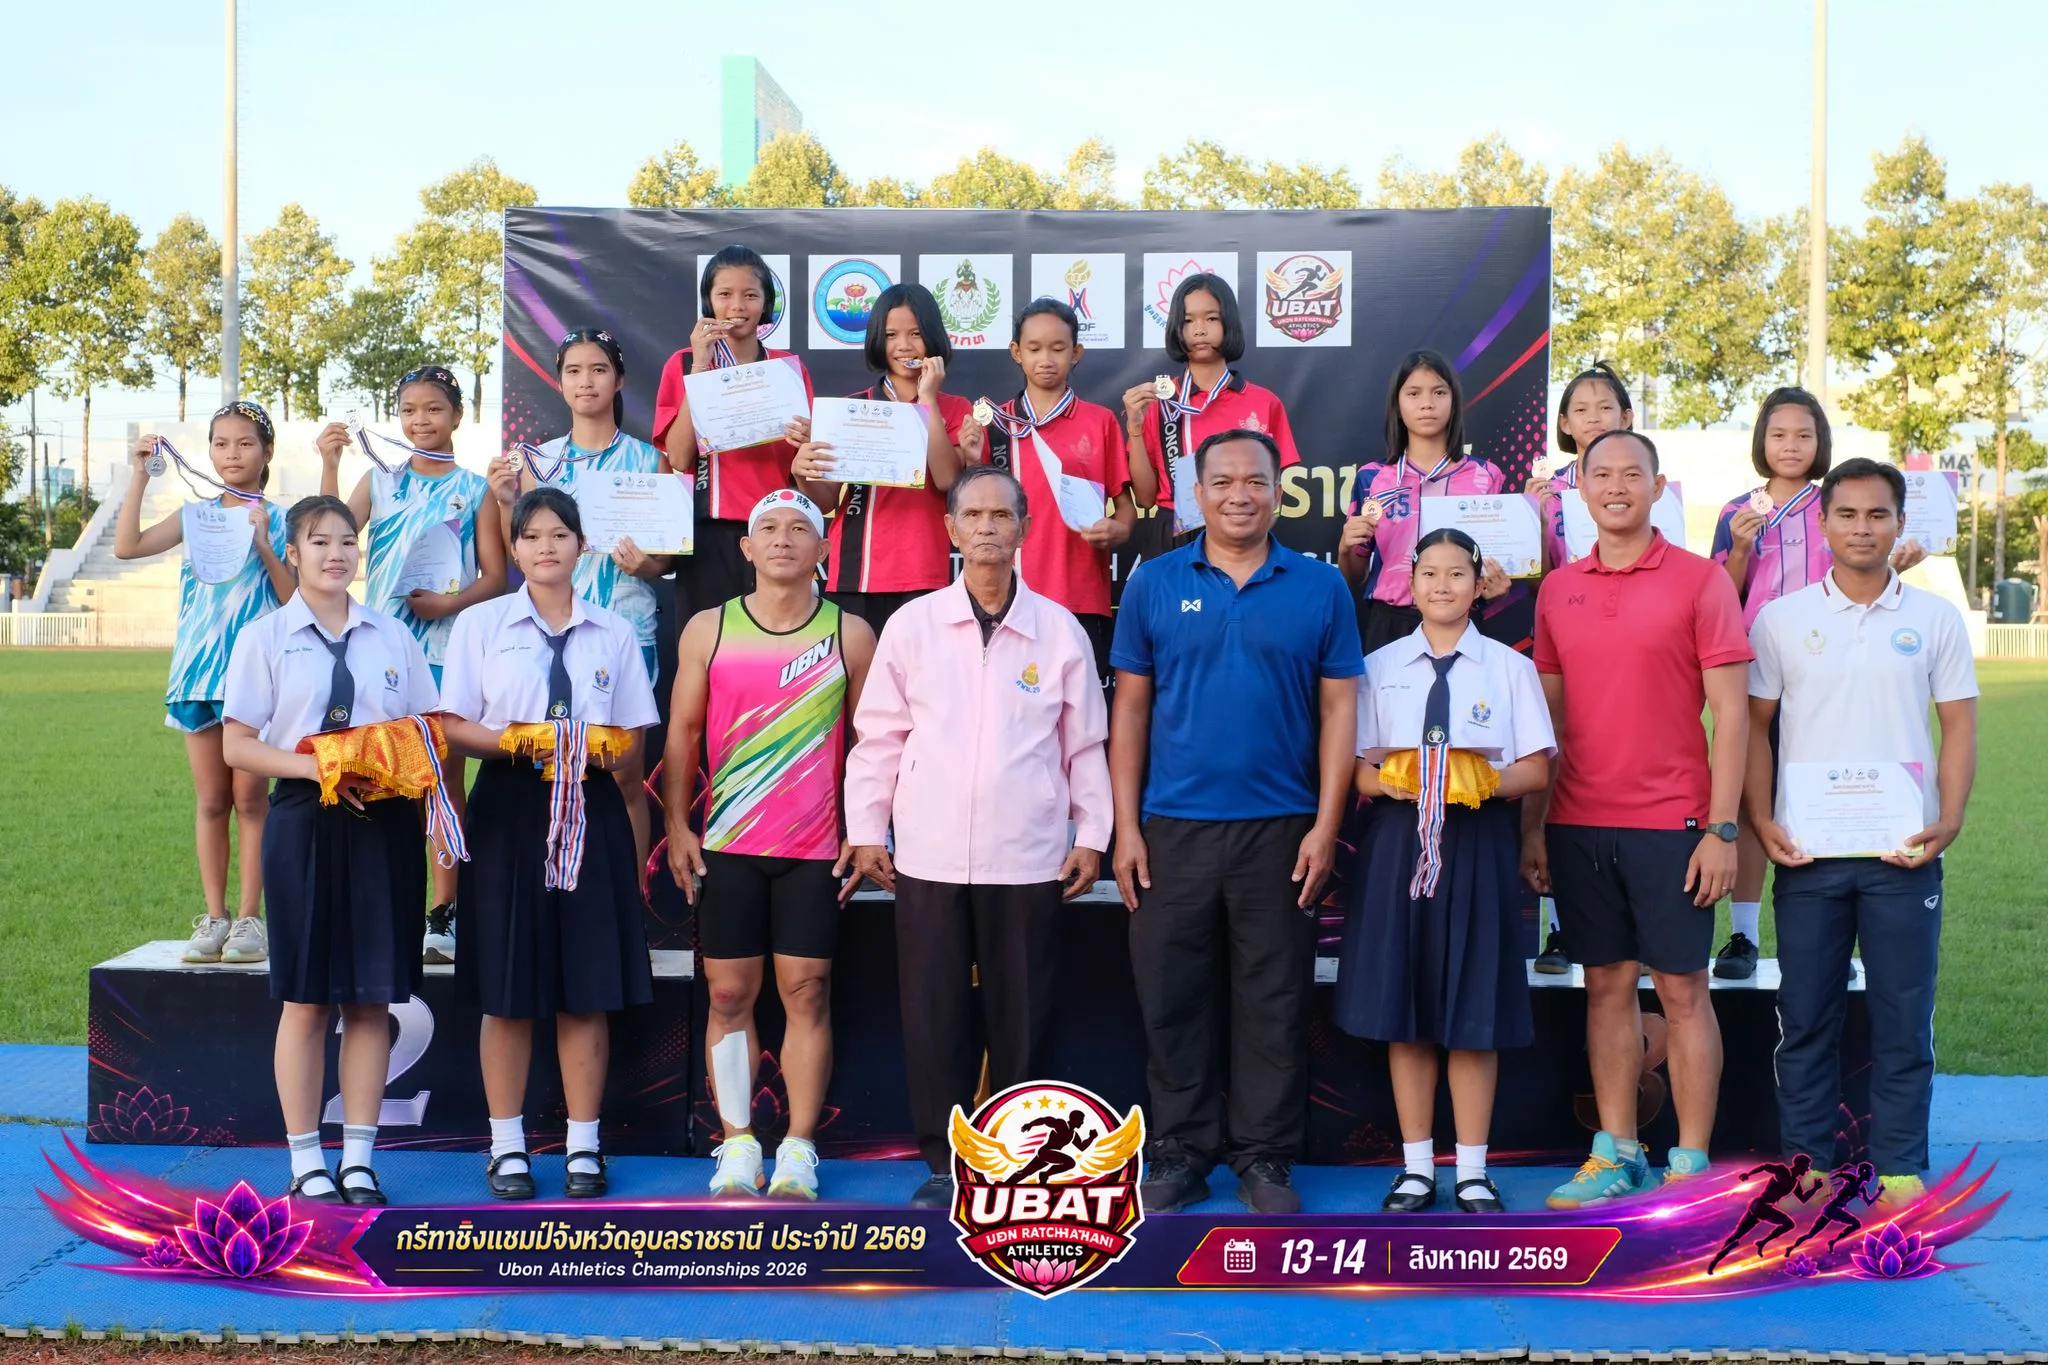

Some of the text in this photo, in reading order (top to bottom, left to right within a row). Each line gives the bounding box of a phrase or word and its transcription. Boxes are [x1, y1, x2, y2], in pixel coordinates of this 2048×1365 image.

[1271, 300, 1336, 317] UBAT
[993, 444, 1009, 470] NO
[1939, 454, 1974, 469] MA
[696, 455, 709, 491] ANG
[779, 633, 834, 688] UBN
